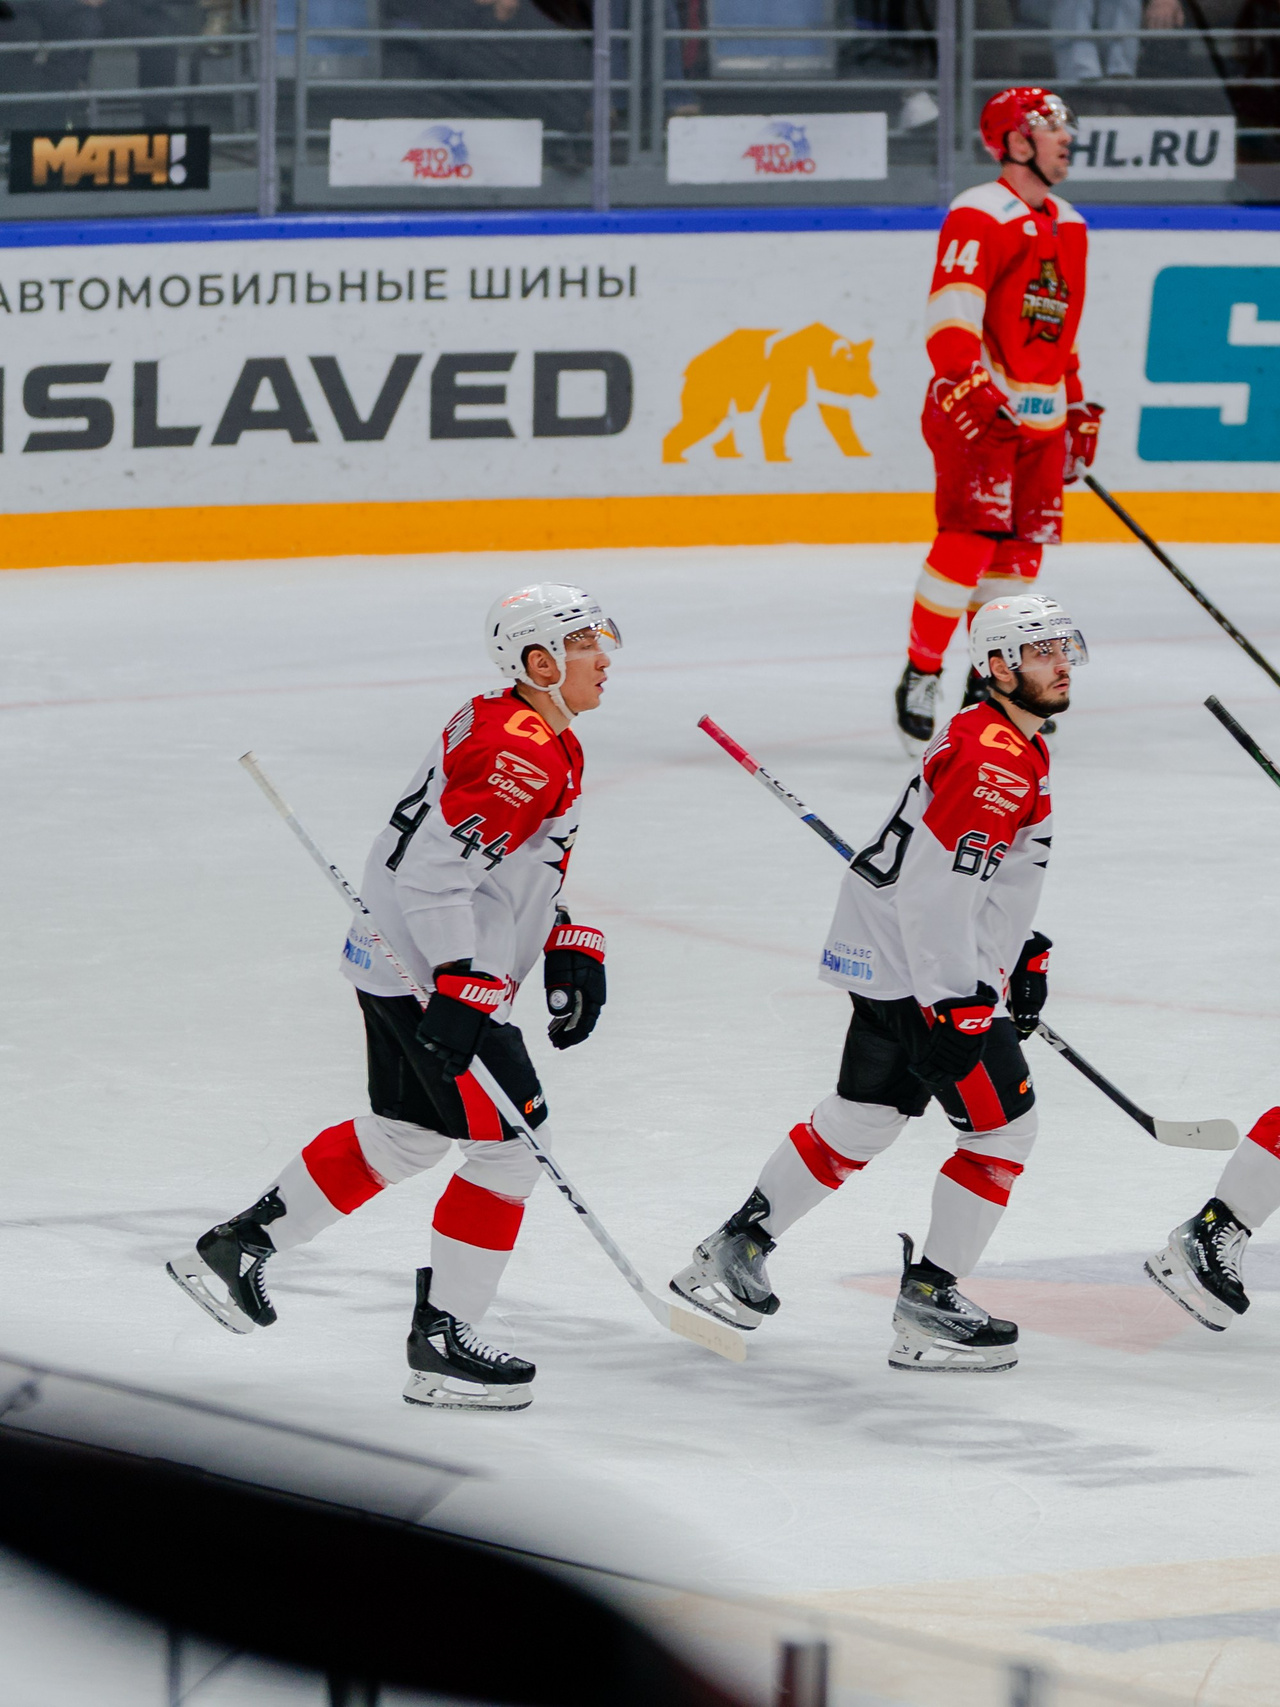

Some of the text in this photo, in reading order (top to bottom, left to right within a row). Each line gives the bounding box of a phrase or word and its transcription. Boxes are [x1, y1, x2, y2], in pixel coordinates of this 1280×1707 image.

[32, 134, 187, 185] МАТЧ!
[1069, 130, 1220, 167] HL.RU
[940, 238, 979, 275] 44
[470, 266, 638, 299] ШИНЫ
[0, 350, 633, 454] SLAVED
[941, 370, 989, 412] CCM
[512, 628, 536, 638] CCM
[450, 813, 512, 872] 44
[556, 930, 606, 953] WAR
[958, 1017, 993, 1030] CC
